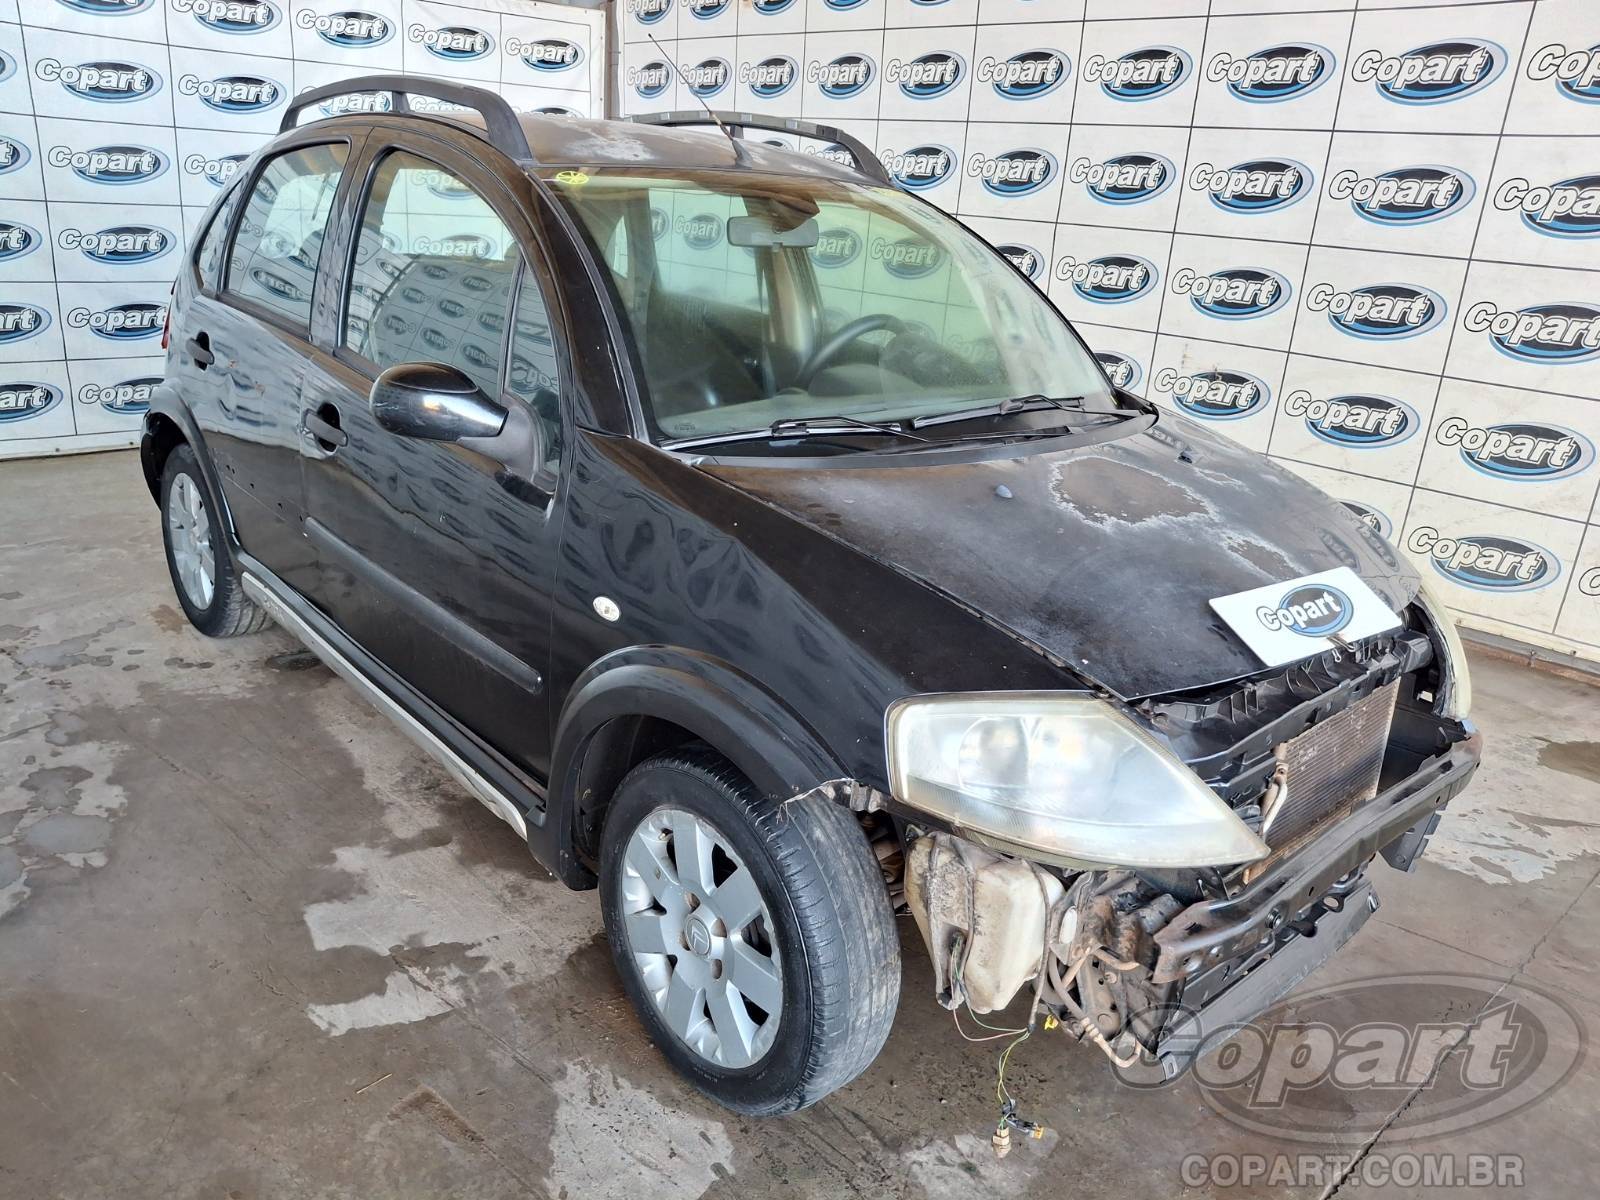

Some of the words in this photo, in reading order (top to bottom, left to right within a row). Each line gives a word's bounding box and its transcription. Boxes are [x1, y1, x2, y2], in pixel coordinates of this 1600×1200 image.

[296, 9, 384, 38] Copart
[408, 24, 485, 52] Copart
[505, 38, 578, 64] Copart
[1527, 44, 1600, 89] Cop
[35, 58, 147, 91] Copart
[627, 64, 668, 91] Copart
[680, 62, 725, 89] Copart
[739, 60, 790, 88] Copart
[807, 58, 867, 89] Copart
[886, 57, 958, 89] Copart
[977, 55, 1063, 89] Copart
[1083, 53, 1177, 89] Copart
[1206, 49, 1319, 90] Copart
[1351, 46, 1488, 91] Copart
[179, 74, 275, 103] Copart
[48, 146, 155, 174] Copart
[185, 154, 242, 181] Cop
[880, 149, 948, 180] Copart
[967, 153, 1048, 183] Copart
[1070, 157, 1164, 191] Copart
[1189, 162, 1298, 200] Copart
[1329, 169, 1458, 210] Copart
[1494, 178, 1600, 222] Copa
[58, 228, 161, 256] Copart
[675, 215, 719, 239] Copart
[414, 236, 489, 257] Copart
[816, 235, 852, 257] part
[870, 237, 936, 266] Copart
[1056, 256, 1147, 290] Copart
[1172, 268, 1278, 306] Copart
[1306, 283, 1431, 326] Copart
[1463, 301, 1600, 347] Copart
[0, 386, 47, 410] art
[79, 383, 156, 408] Copa
[1154, 367, 1258, 409] Copart
[1284, 389, 1404, 436] Copart
[1436, 416, 1576, 468] Copart
[1407, 526, 1541, 581] Copart
[1256, 591, 1343, 631] Copart
